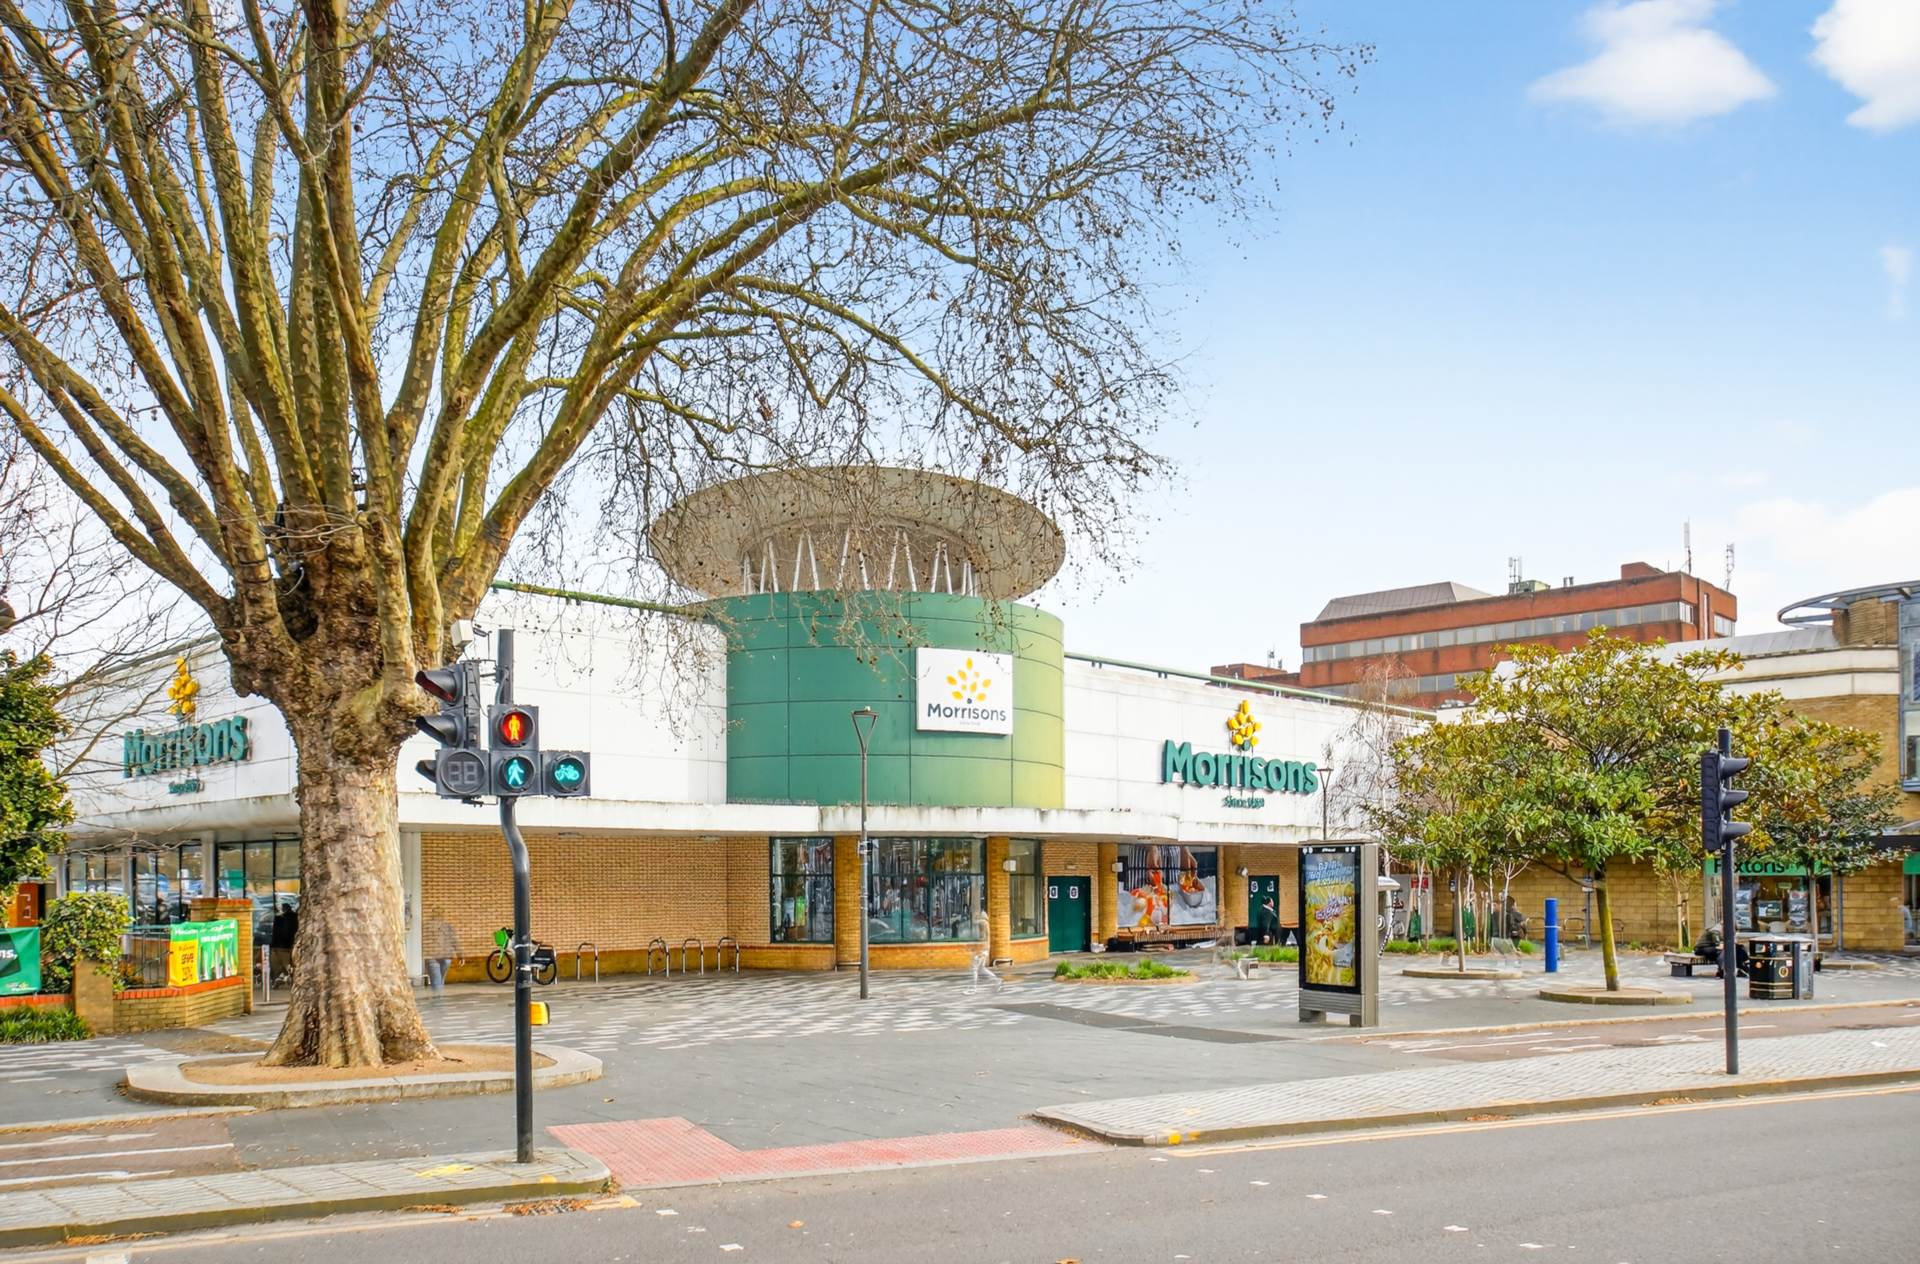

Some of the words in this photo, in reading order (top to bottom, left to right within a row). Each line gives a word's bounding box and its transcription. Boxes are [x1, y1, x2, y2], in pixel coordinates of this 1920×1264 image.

[927, 703, 1007, 721] Morrisons
[123, 715, 249, 778] Morrisons
[1162, 740, 1319, 793] Morrisons
[1713, 858, 1785, 874] Fxtons
